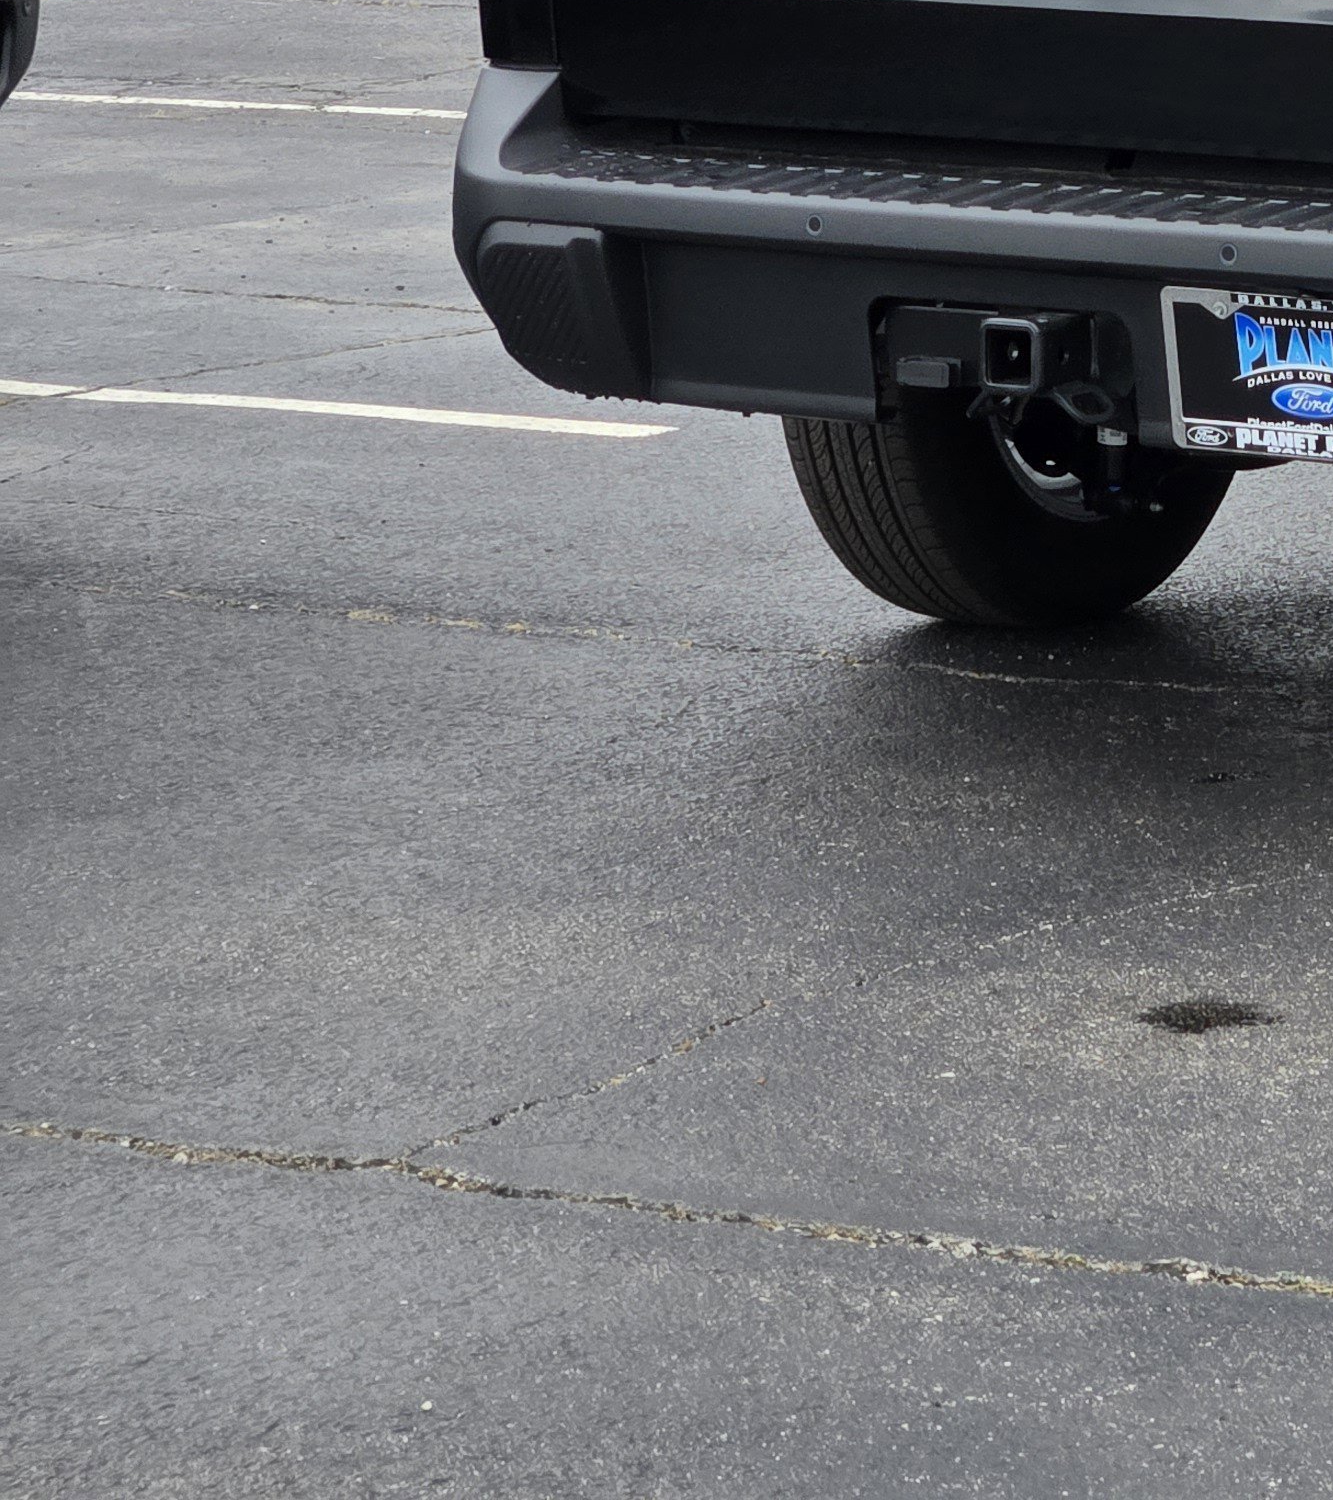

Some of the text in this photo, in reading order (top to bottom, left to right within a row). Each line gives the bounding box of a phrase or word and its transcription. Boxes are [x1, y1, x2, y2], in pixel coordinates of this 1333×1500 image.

[1247, 371, 1294, 388] DALLAS
[1298, 371, 1332, 383] LOVE
[1195, 428, 1220, 444] Ford
[1235, 427, 1319, 451] PLANET
